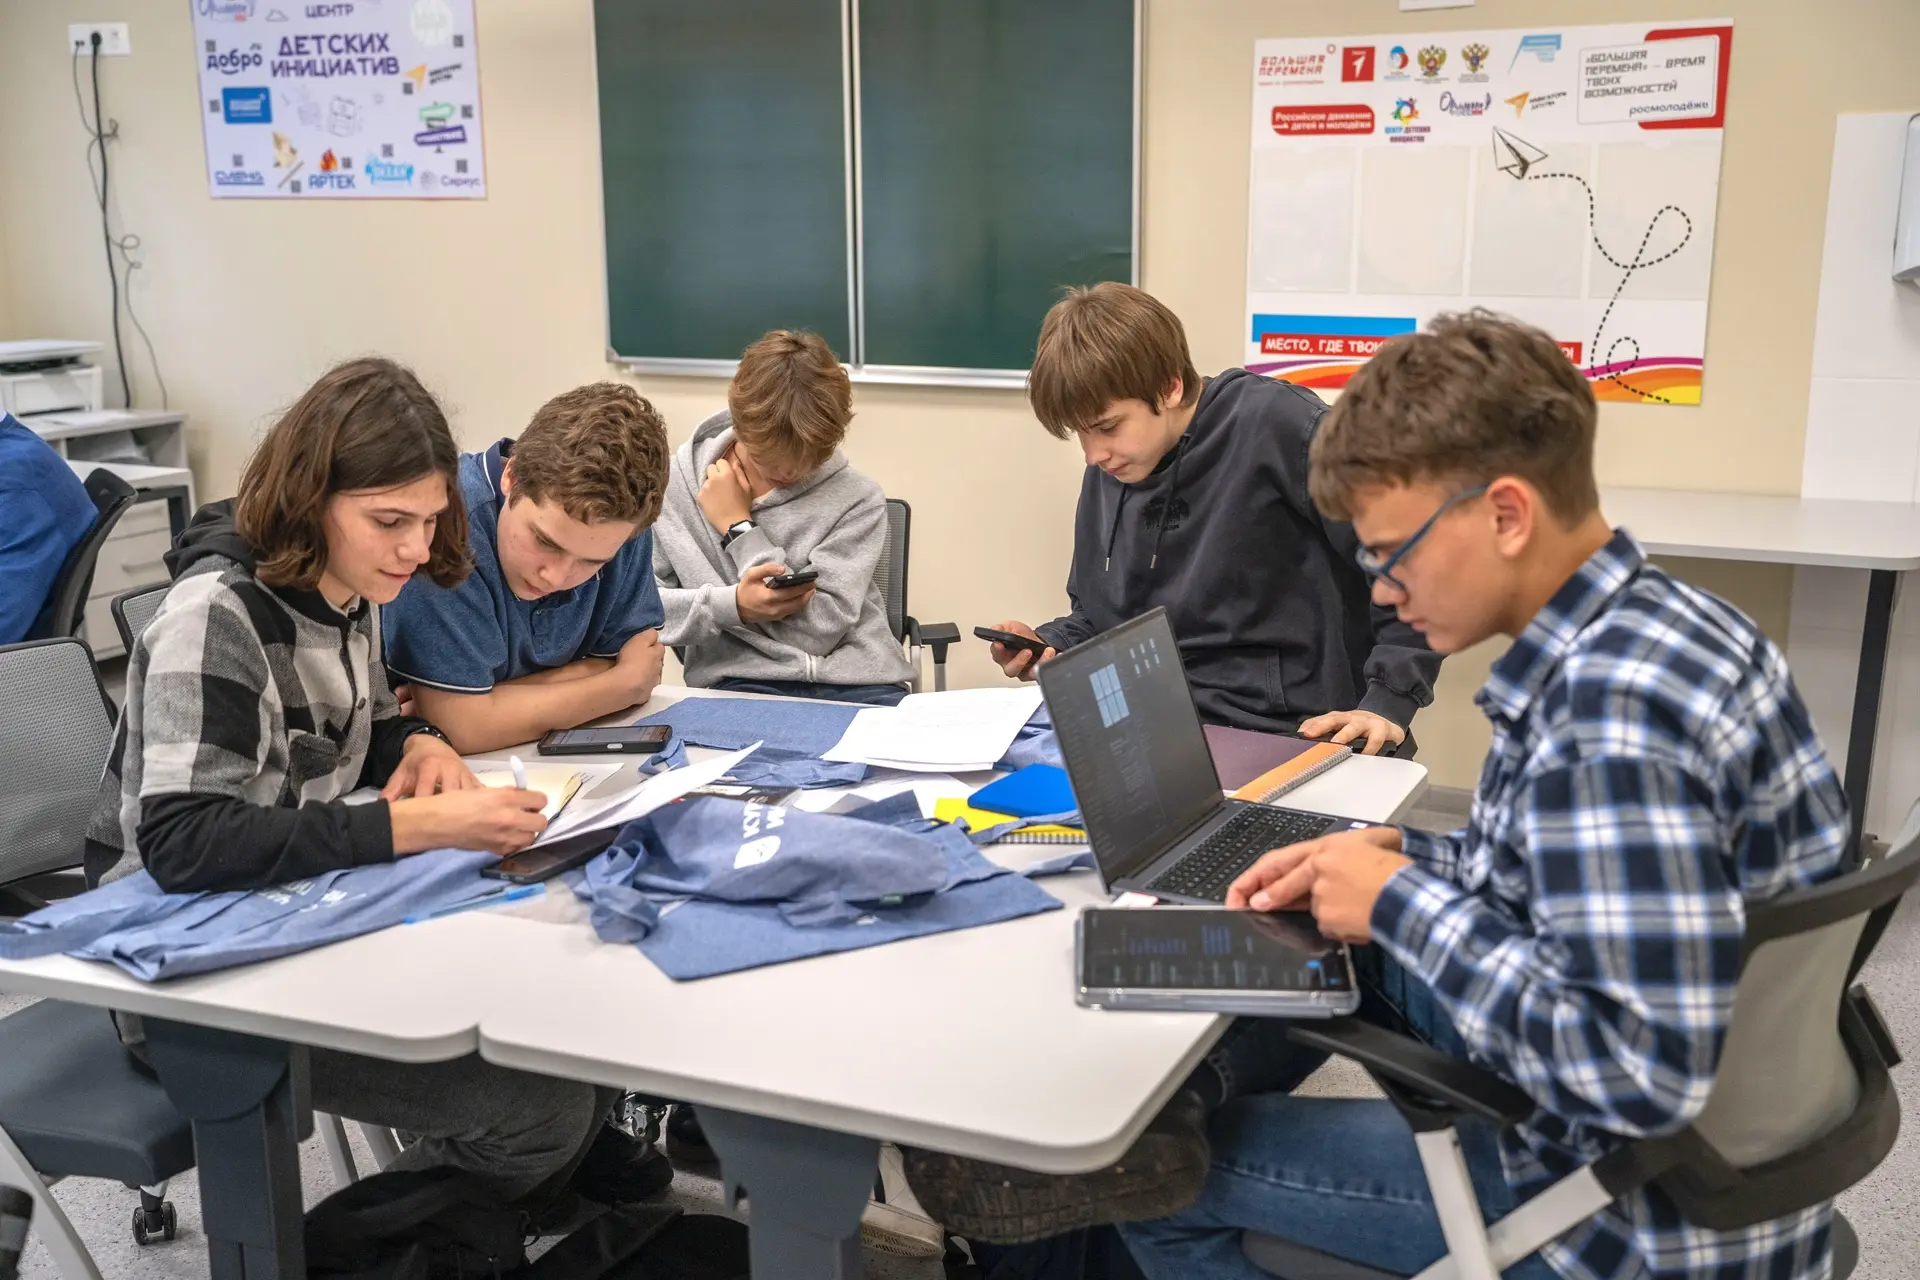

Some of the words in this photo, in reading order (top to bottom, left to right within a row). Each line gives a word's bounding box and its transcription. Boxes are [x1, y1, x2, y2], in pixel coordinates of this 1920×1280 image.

[306, 4, 354, 18] ЦЕНТР
[278, 33, 390, 56] ДЕТСКИХ
[271, 57, 400, 77] ИНИЦИАТИВ
[1261, 55, 1326, 65] БОЛЬШАЯ
[1665, 56, 1706, 69] ВРЕМЯ
[1259, 66, 1323, 76] ПЕРЕМЕНА
[1586, 76, 1622, 87] ТВОИХ
[1584, 80, 1678, 99] ВОЗМОЖНОСТЕЙ
[1265, 338, 1313, 353] МЕСТО,
[1318, 339, 1343, 353] ГДЕ
